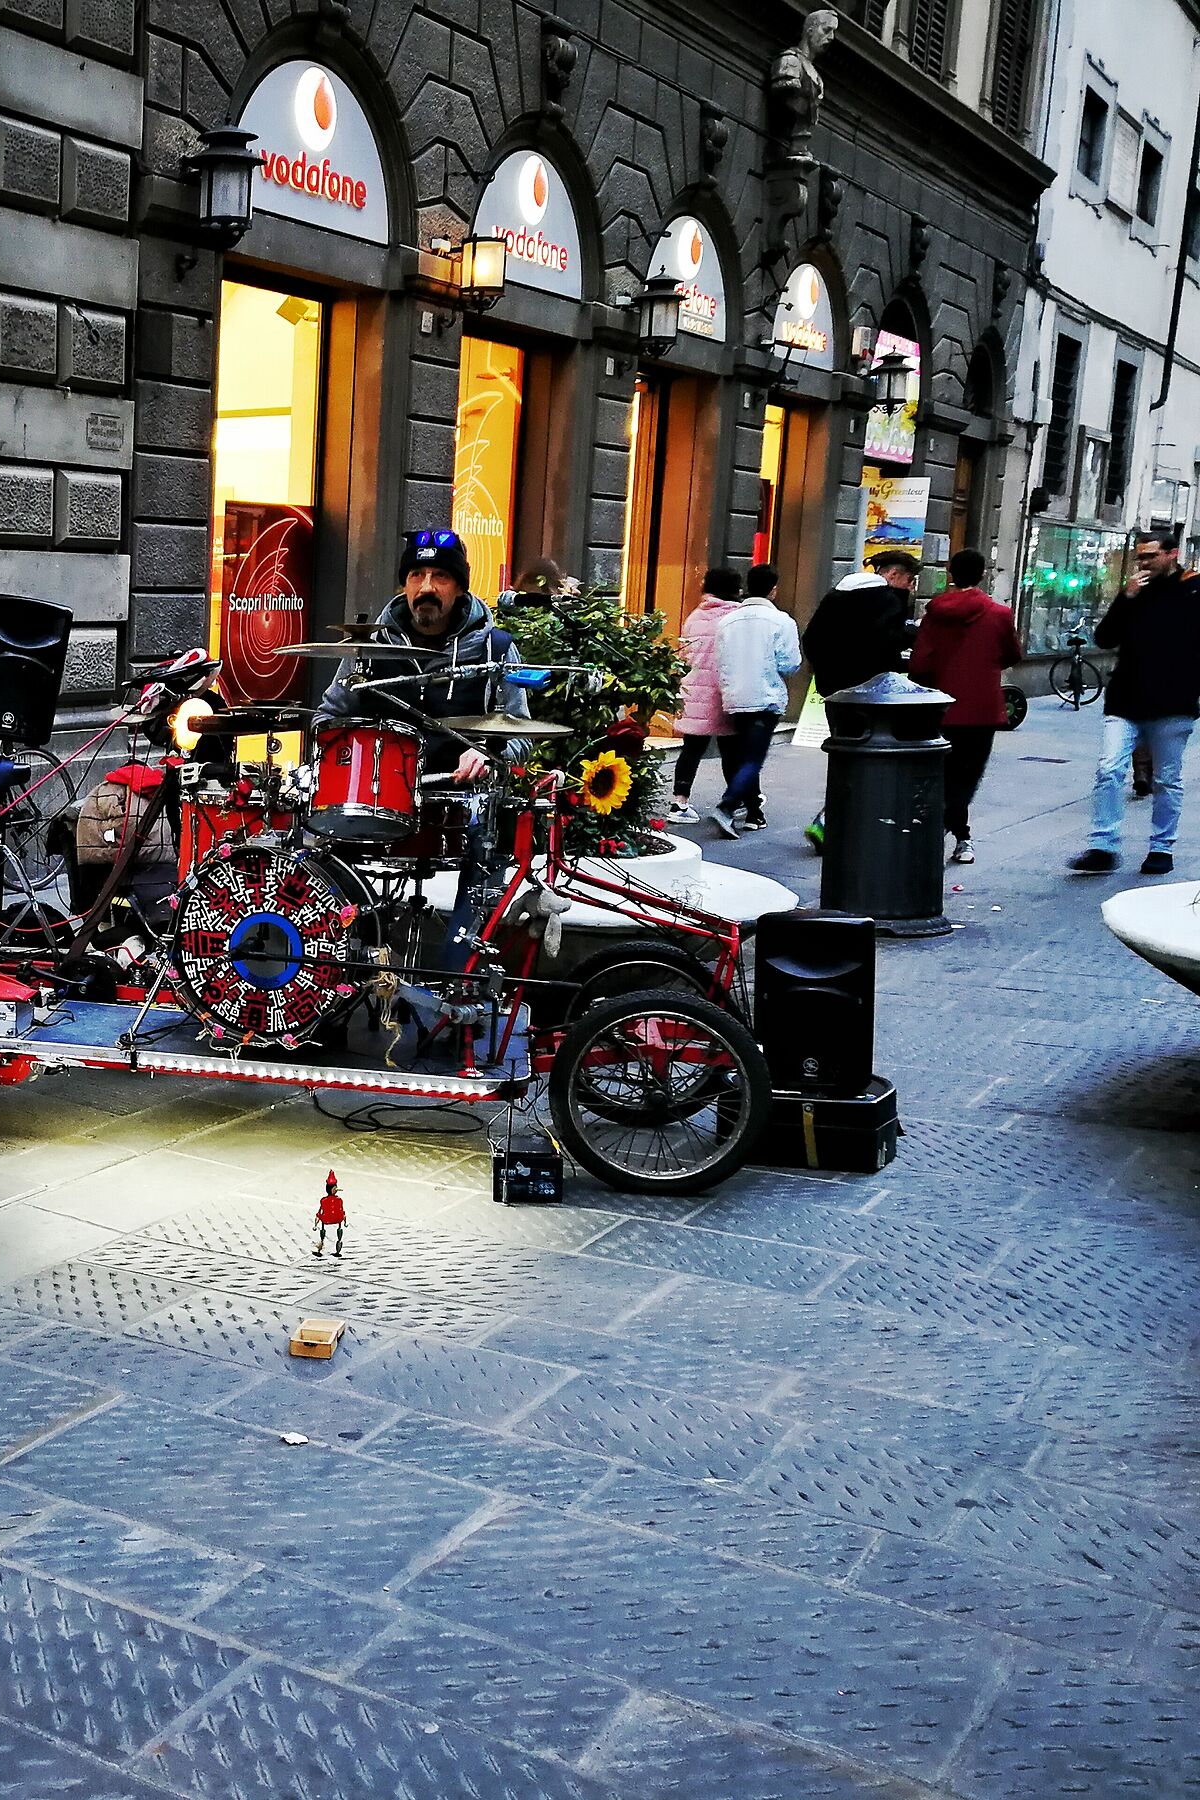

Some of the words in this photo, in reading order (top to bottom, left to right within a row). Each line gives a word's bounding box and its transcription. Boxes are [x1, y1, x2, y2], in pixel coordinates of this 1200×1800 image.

[260, 149, 368, 209] vodafone
[493, 225, 568, 271] vodafone
[674, 282, 717, 318] dafone
[229, 593, 262, 615] Scopri
[263, 593, 304, 611] l'Infinito
